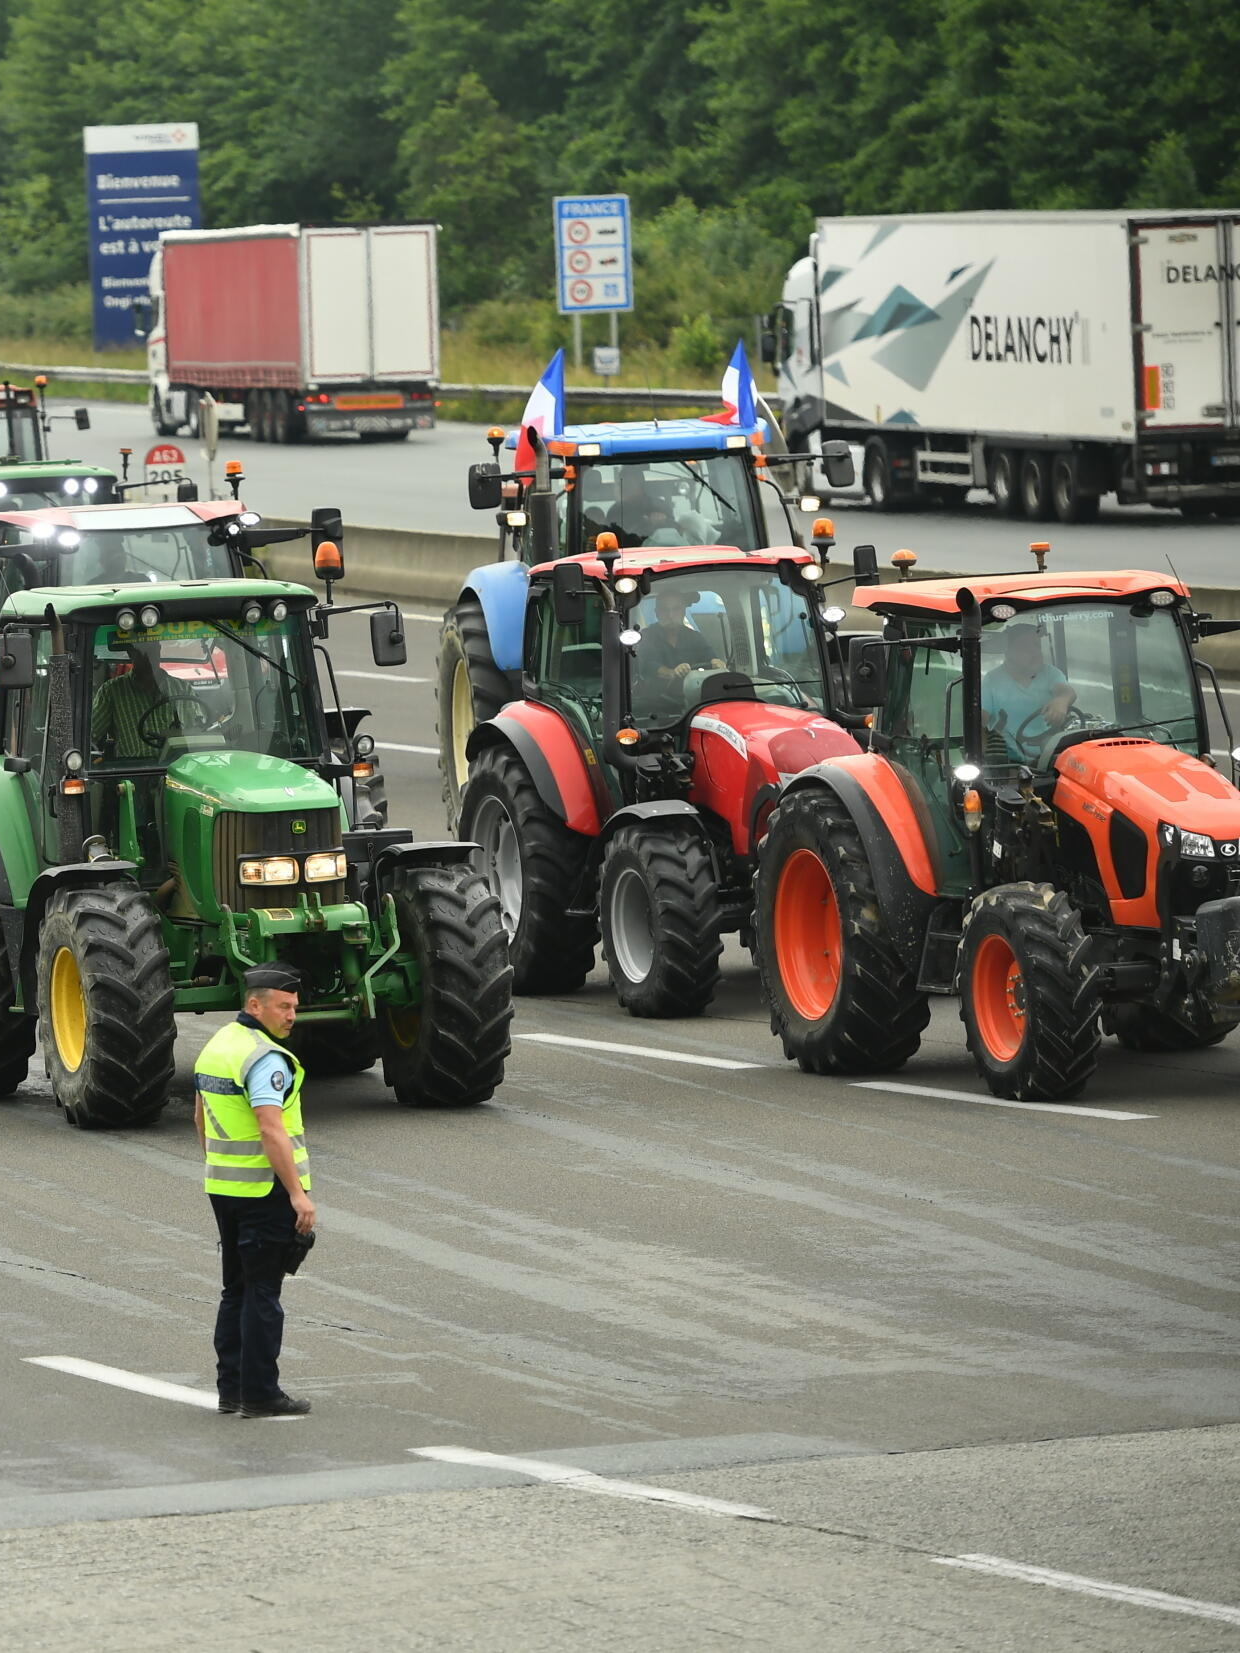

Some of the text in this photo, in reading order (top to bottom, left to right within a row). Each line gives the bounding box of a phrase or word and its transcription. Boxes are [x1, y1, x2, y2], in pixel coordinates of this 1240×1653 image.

[97, 173, 179, 190] Bienvenue
[563, 202, 619, 216] FRANCE
[98, 214, 192, 231] L'autoroute
[99, 239, 125, 255] est
[128, 237, 140, 254] à
[969, 314, 1075, 365] DELANCHY
[153, 449, 178, 463] A63
[149, 469, 183, 484] 205
